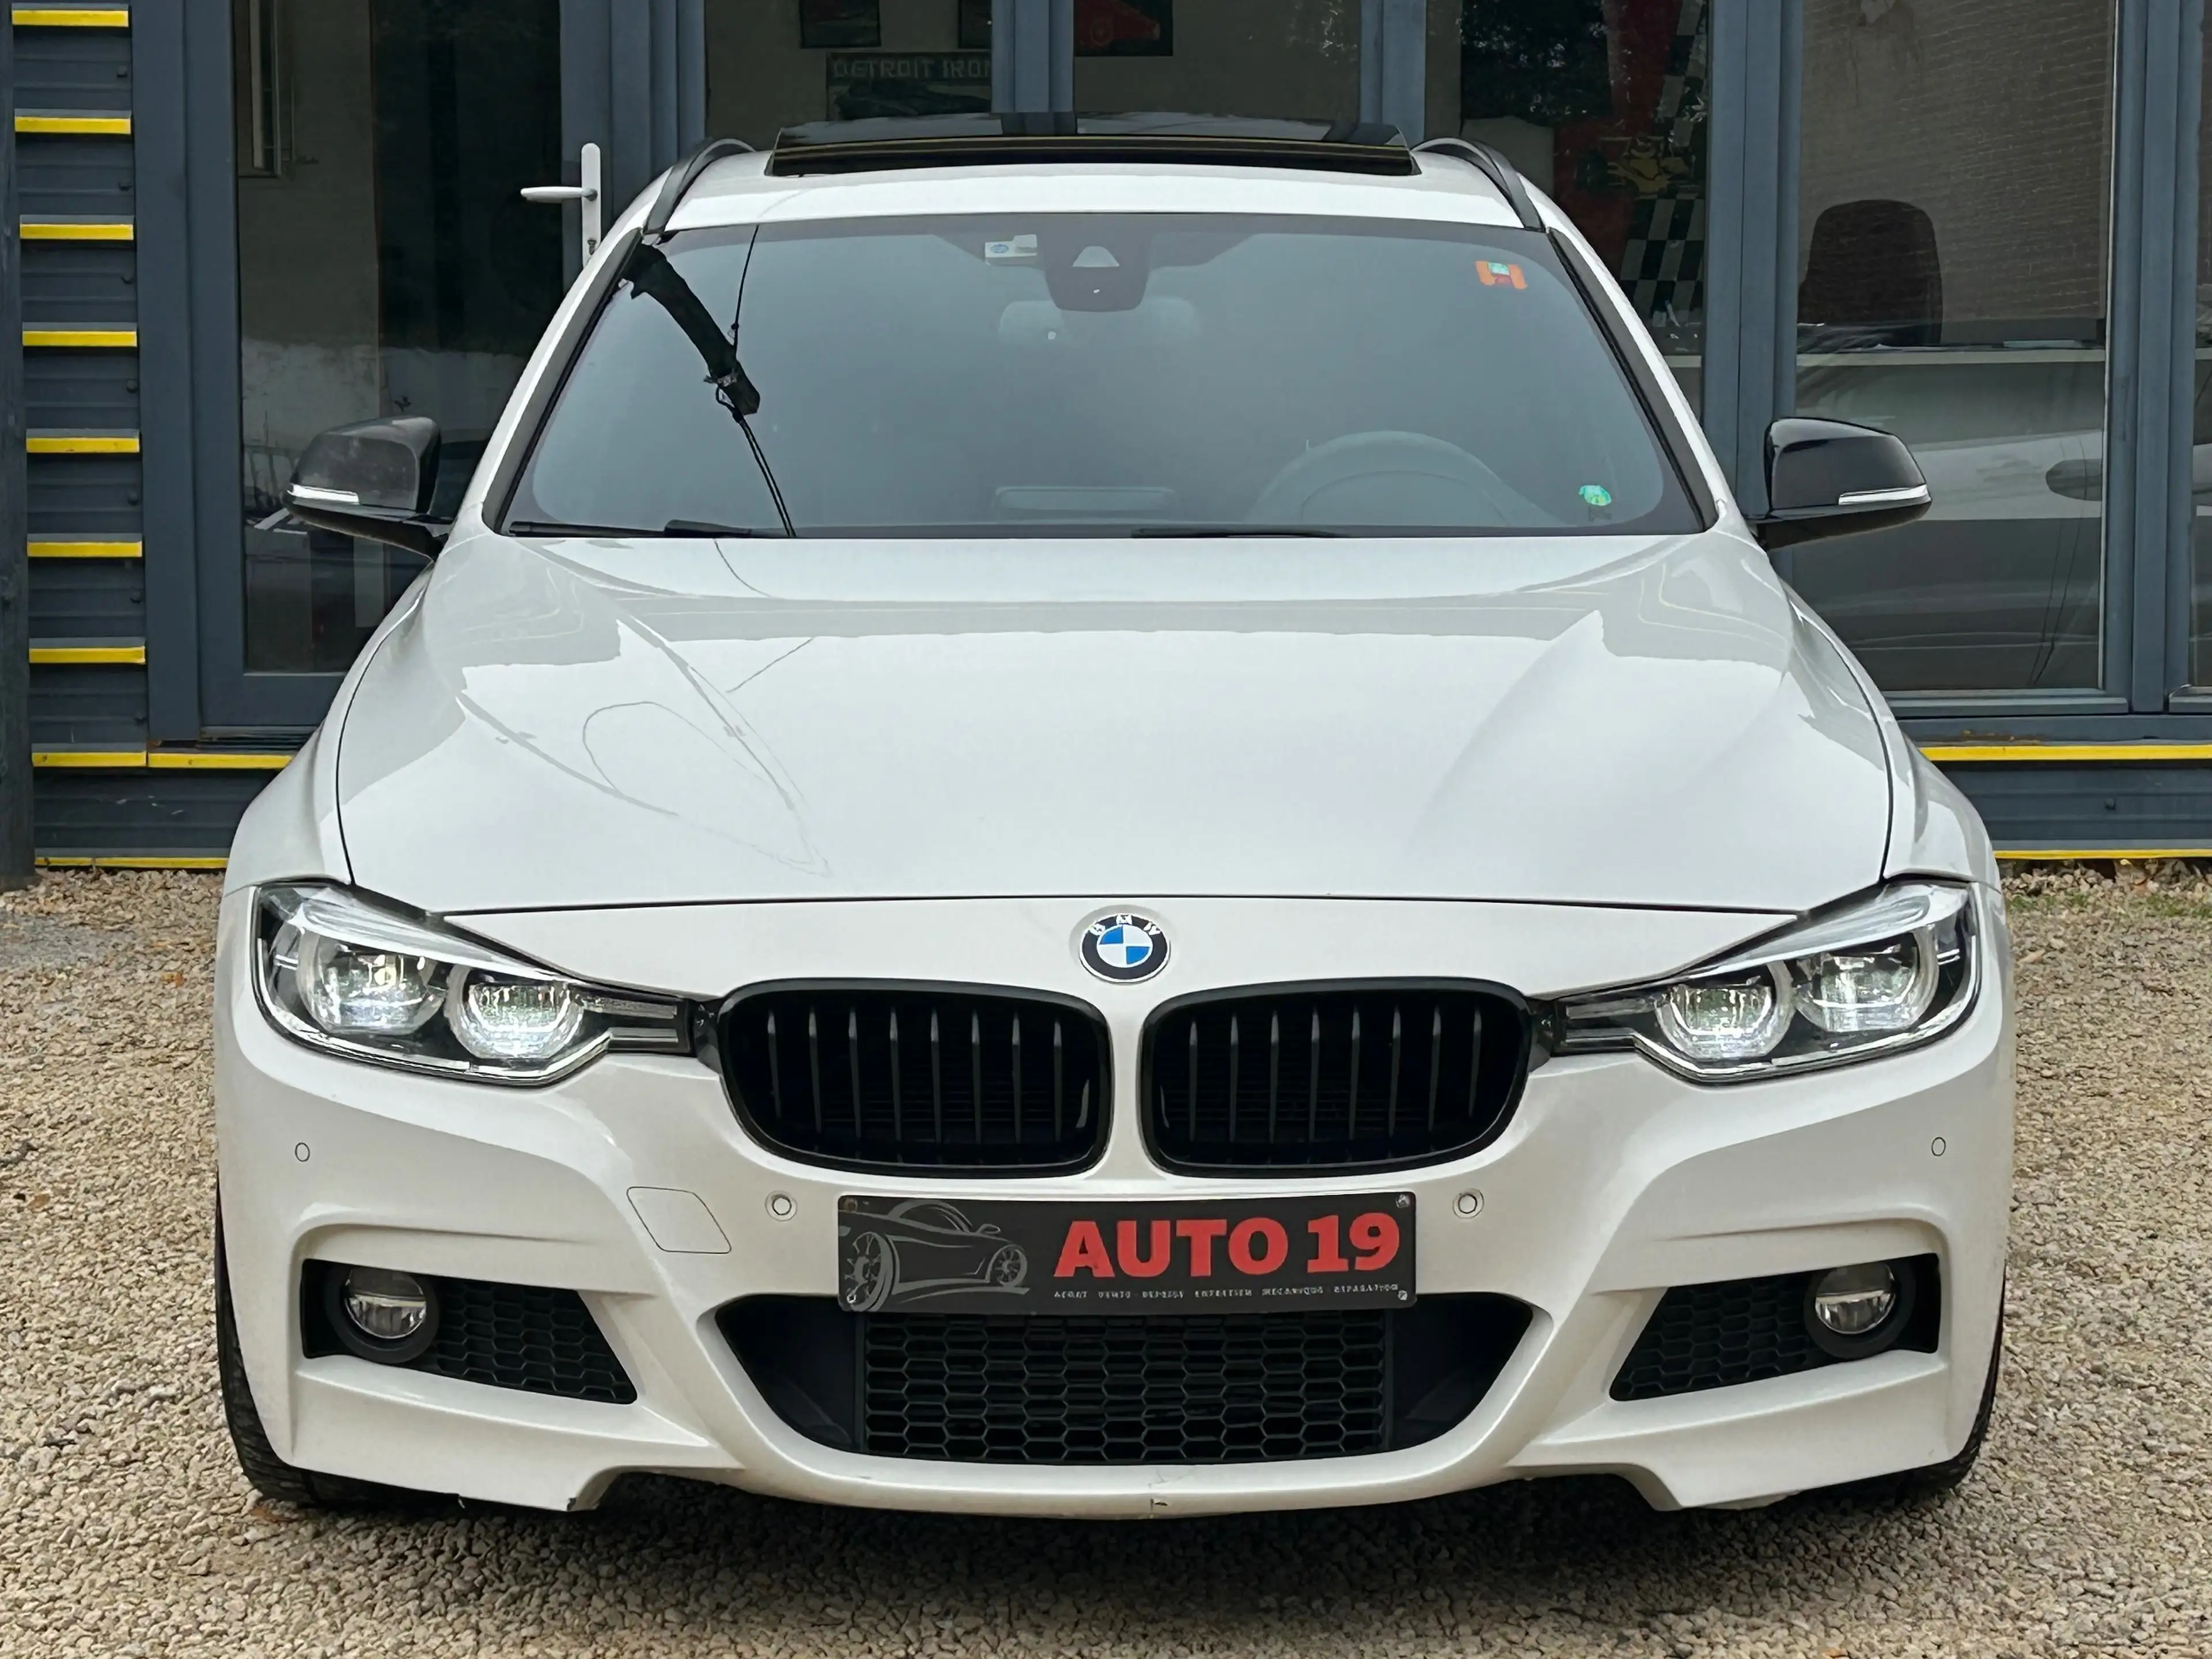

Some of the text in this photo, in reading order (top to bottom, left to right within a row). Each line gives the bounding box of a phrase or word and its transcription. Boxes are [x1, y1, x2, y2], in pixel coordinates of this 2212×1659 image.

[832, 58, 935, 78] DETROIT
[1088, 912, 1162, 936] BMW
[1054, 1213, 1400, 1277] AUTO 19
